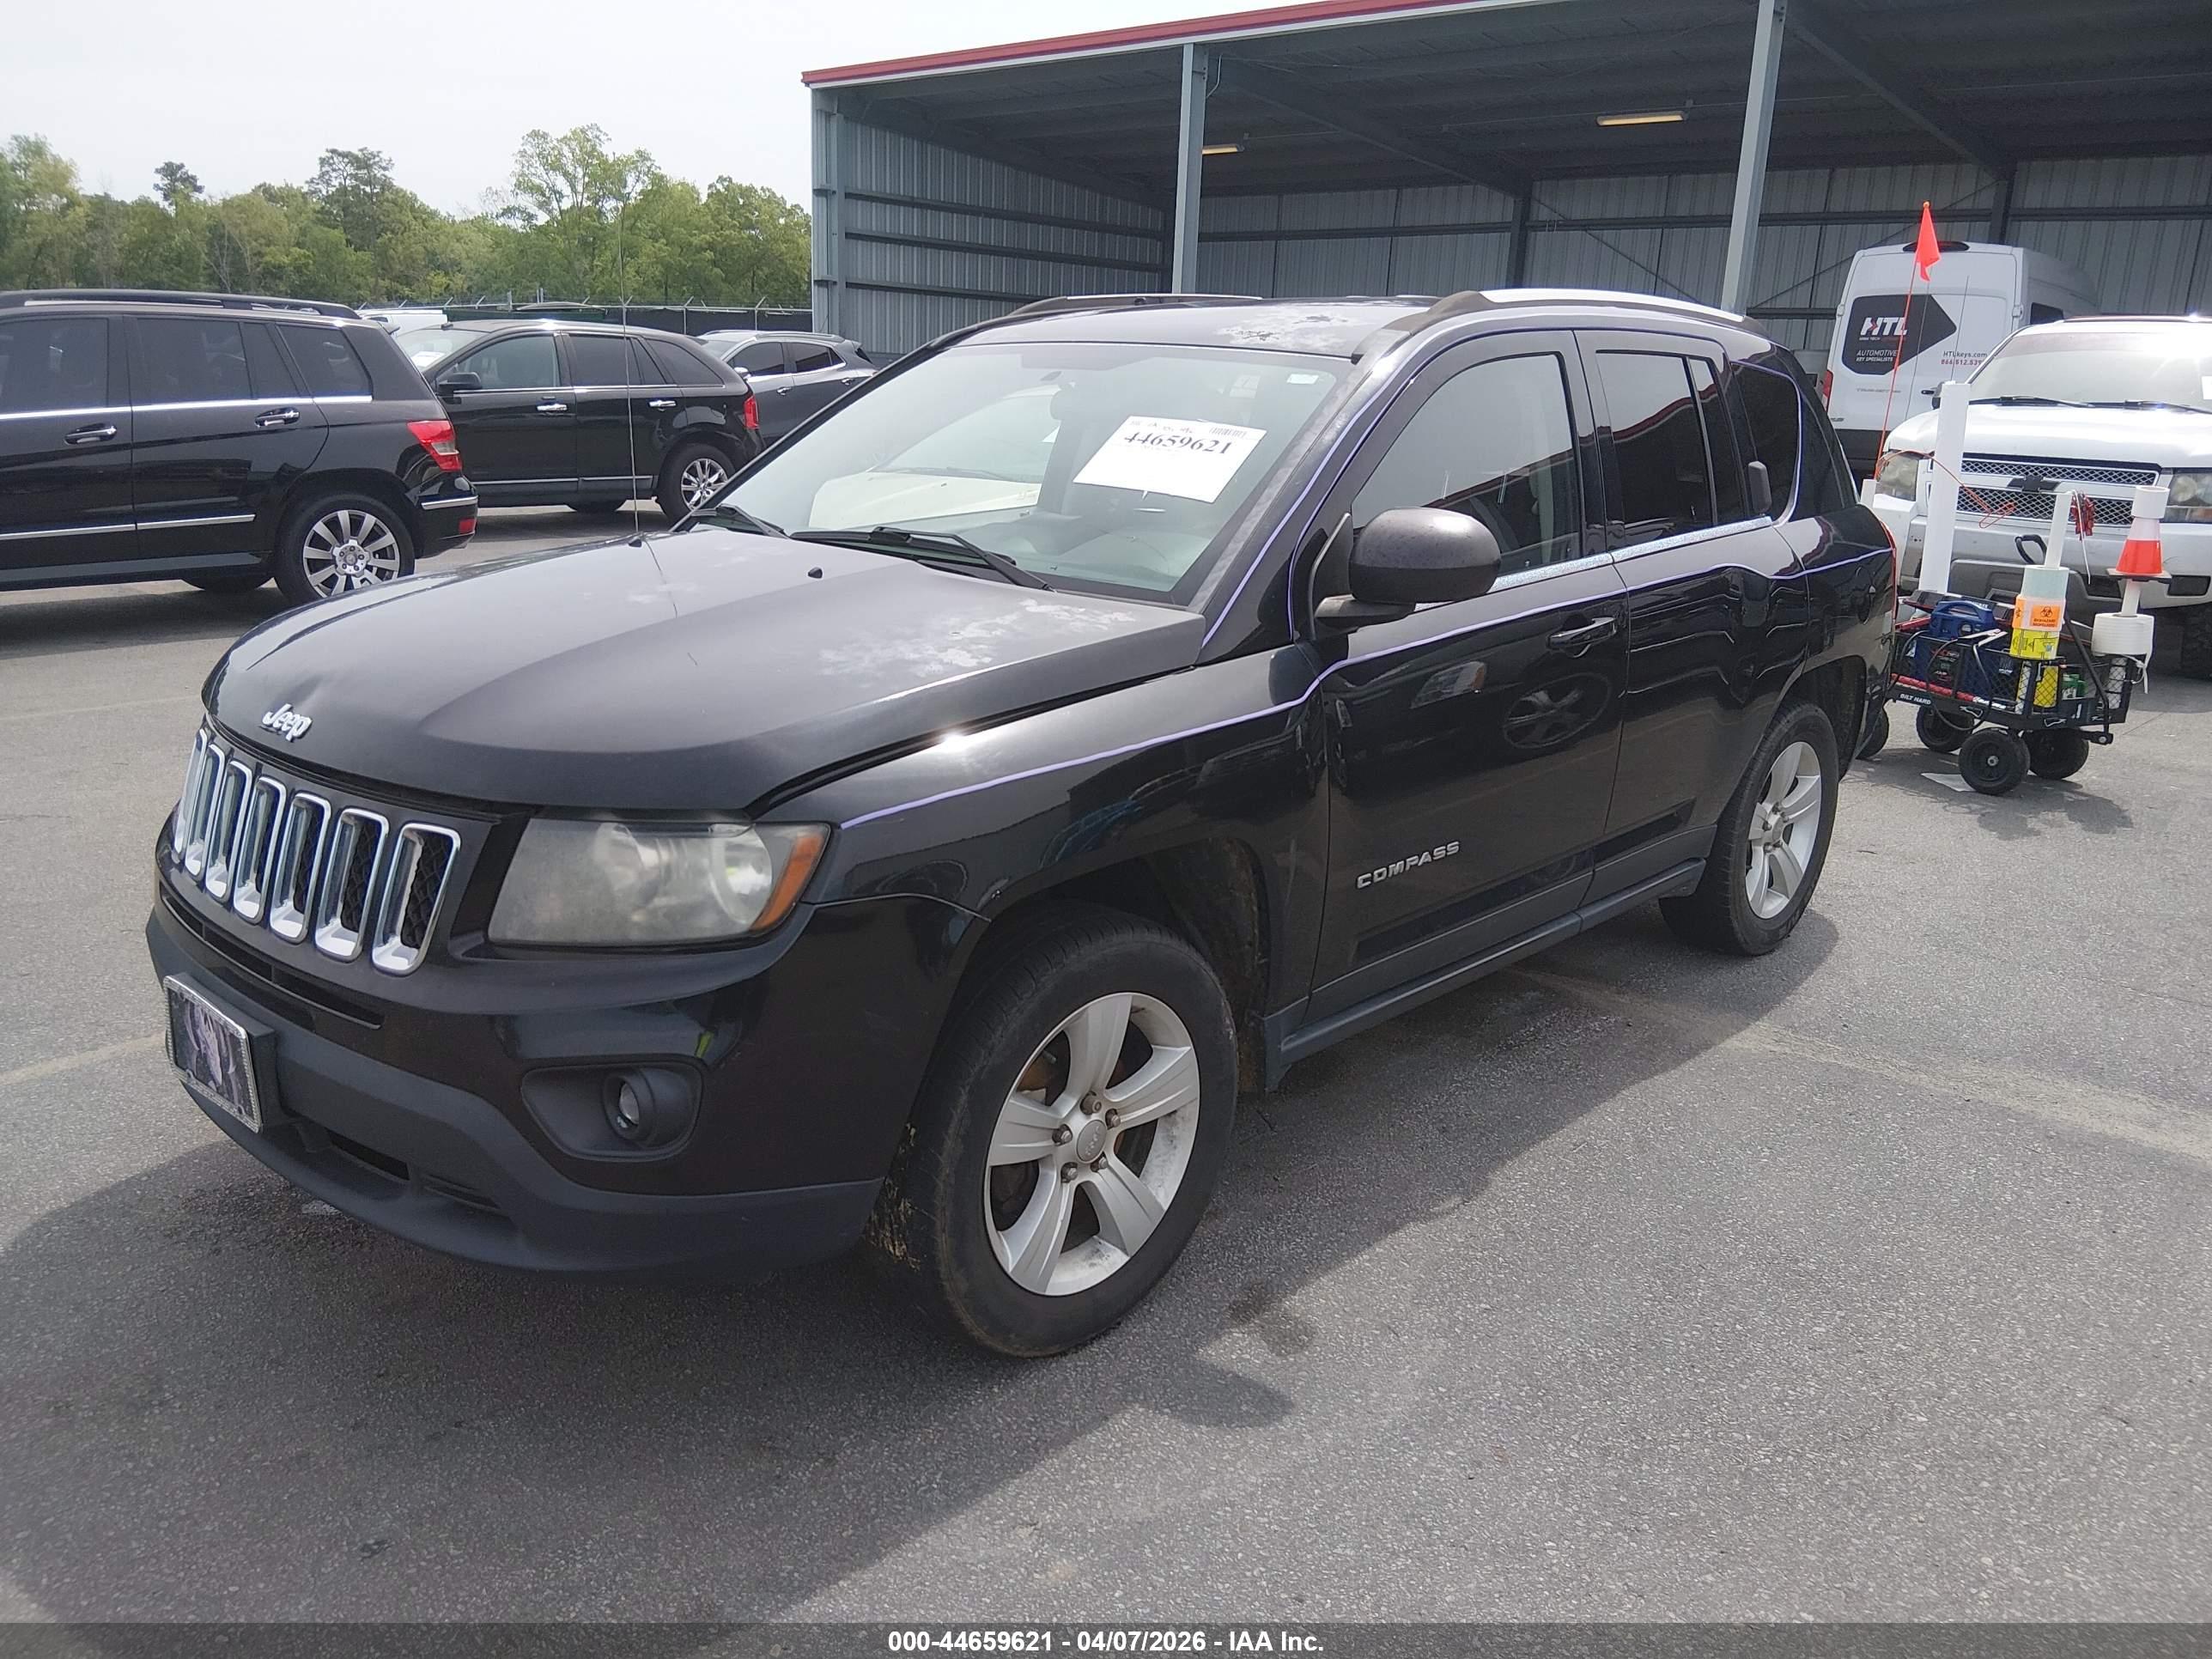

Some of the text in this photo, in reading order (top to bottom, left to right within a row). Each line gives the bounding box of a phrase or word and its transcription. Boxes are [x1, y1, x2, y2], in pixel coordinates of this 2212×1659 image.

[1860, 317, 1908, 336] HTL
[1943, 350, 1988, 359] HTLkeys.com
[1124, 431, 1233, 454] 44659621
[1913, 696, 1932, 705] HARD
[261, 702, 313, 742] Jeep
[1356, 841, 1461, 890] COMPASS
